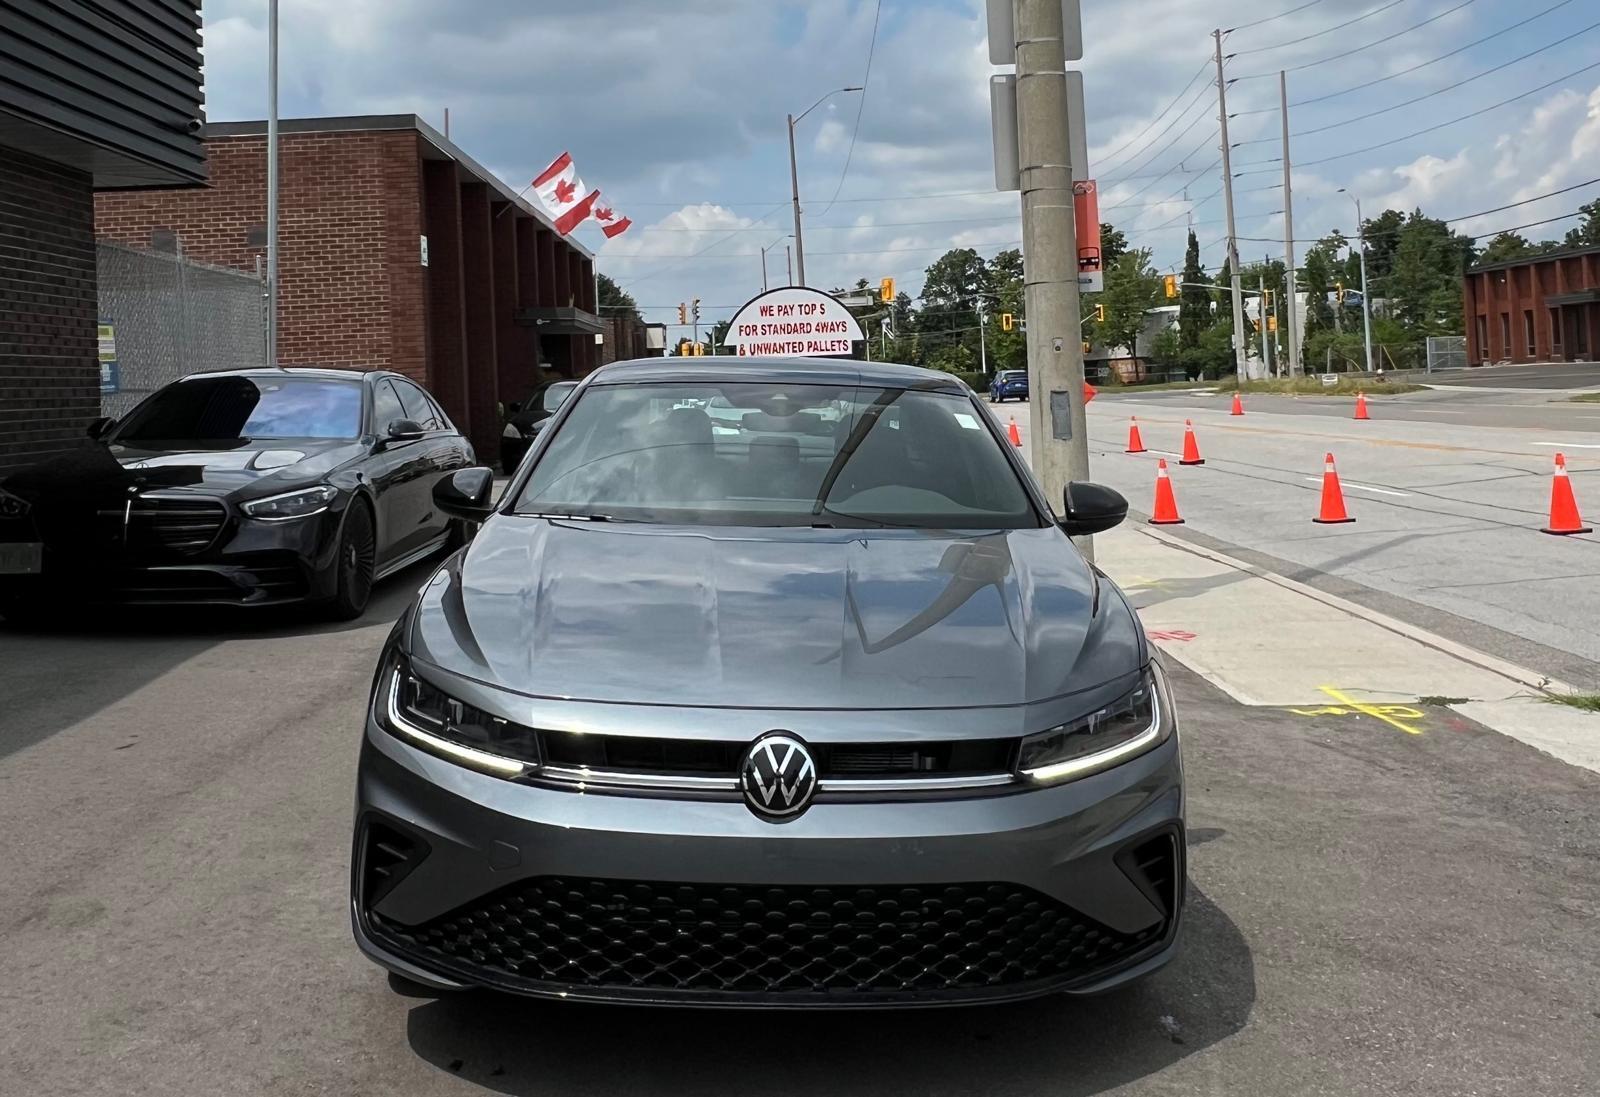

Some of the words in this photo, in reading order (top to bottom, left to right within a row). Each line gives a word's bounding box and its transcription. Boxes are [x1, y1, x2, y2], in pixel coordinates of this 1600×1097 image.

[759, 305, 775, 317] WE
[777, 304, 795, 317] PAY
[798, 303, 817, 316] TOP
[738, 324, 758, 337] FOR
[760, 322, 812, 336] STANDARD
[814, 320, 848, 334] 4WAYS
[738, 343, 746, 356] &
[749, 341, 804, 356] UNWANTED
[806, 339, 849, 353] PALLETS
